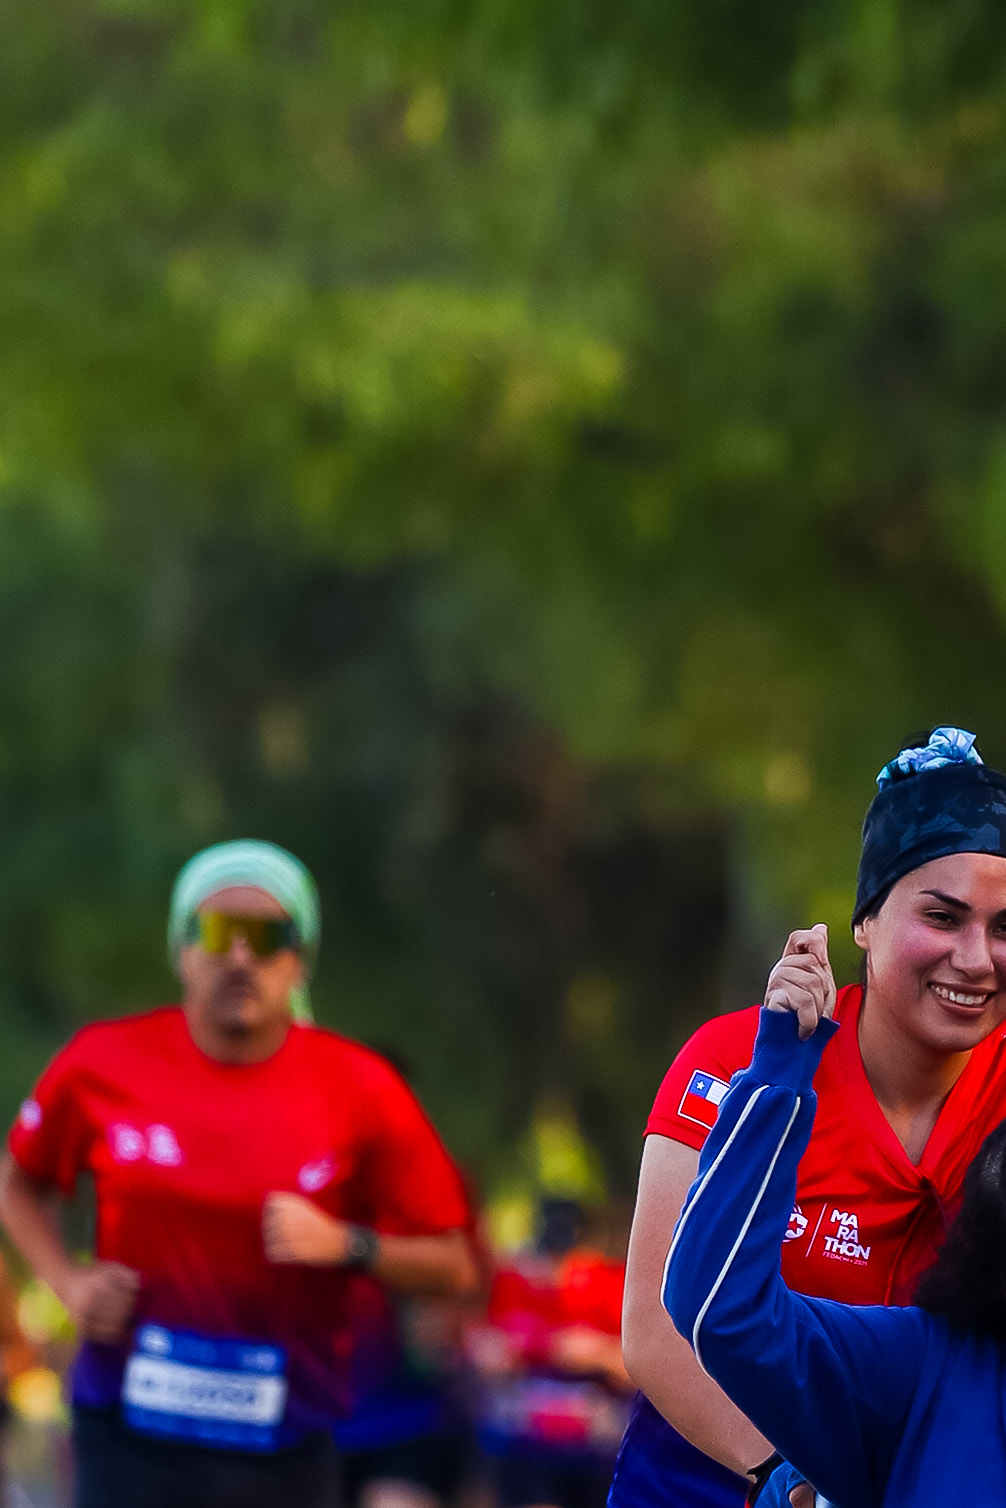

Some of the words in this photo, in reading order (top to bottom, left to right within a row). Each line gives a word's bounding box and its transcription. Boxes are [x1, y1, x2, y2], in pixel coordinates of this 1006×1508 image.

[830, 1209, 858, 1229] MA
[837, 1224, 858, 1243] RA
[824, 1235, 871, 1260] THON
